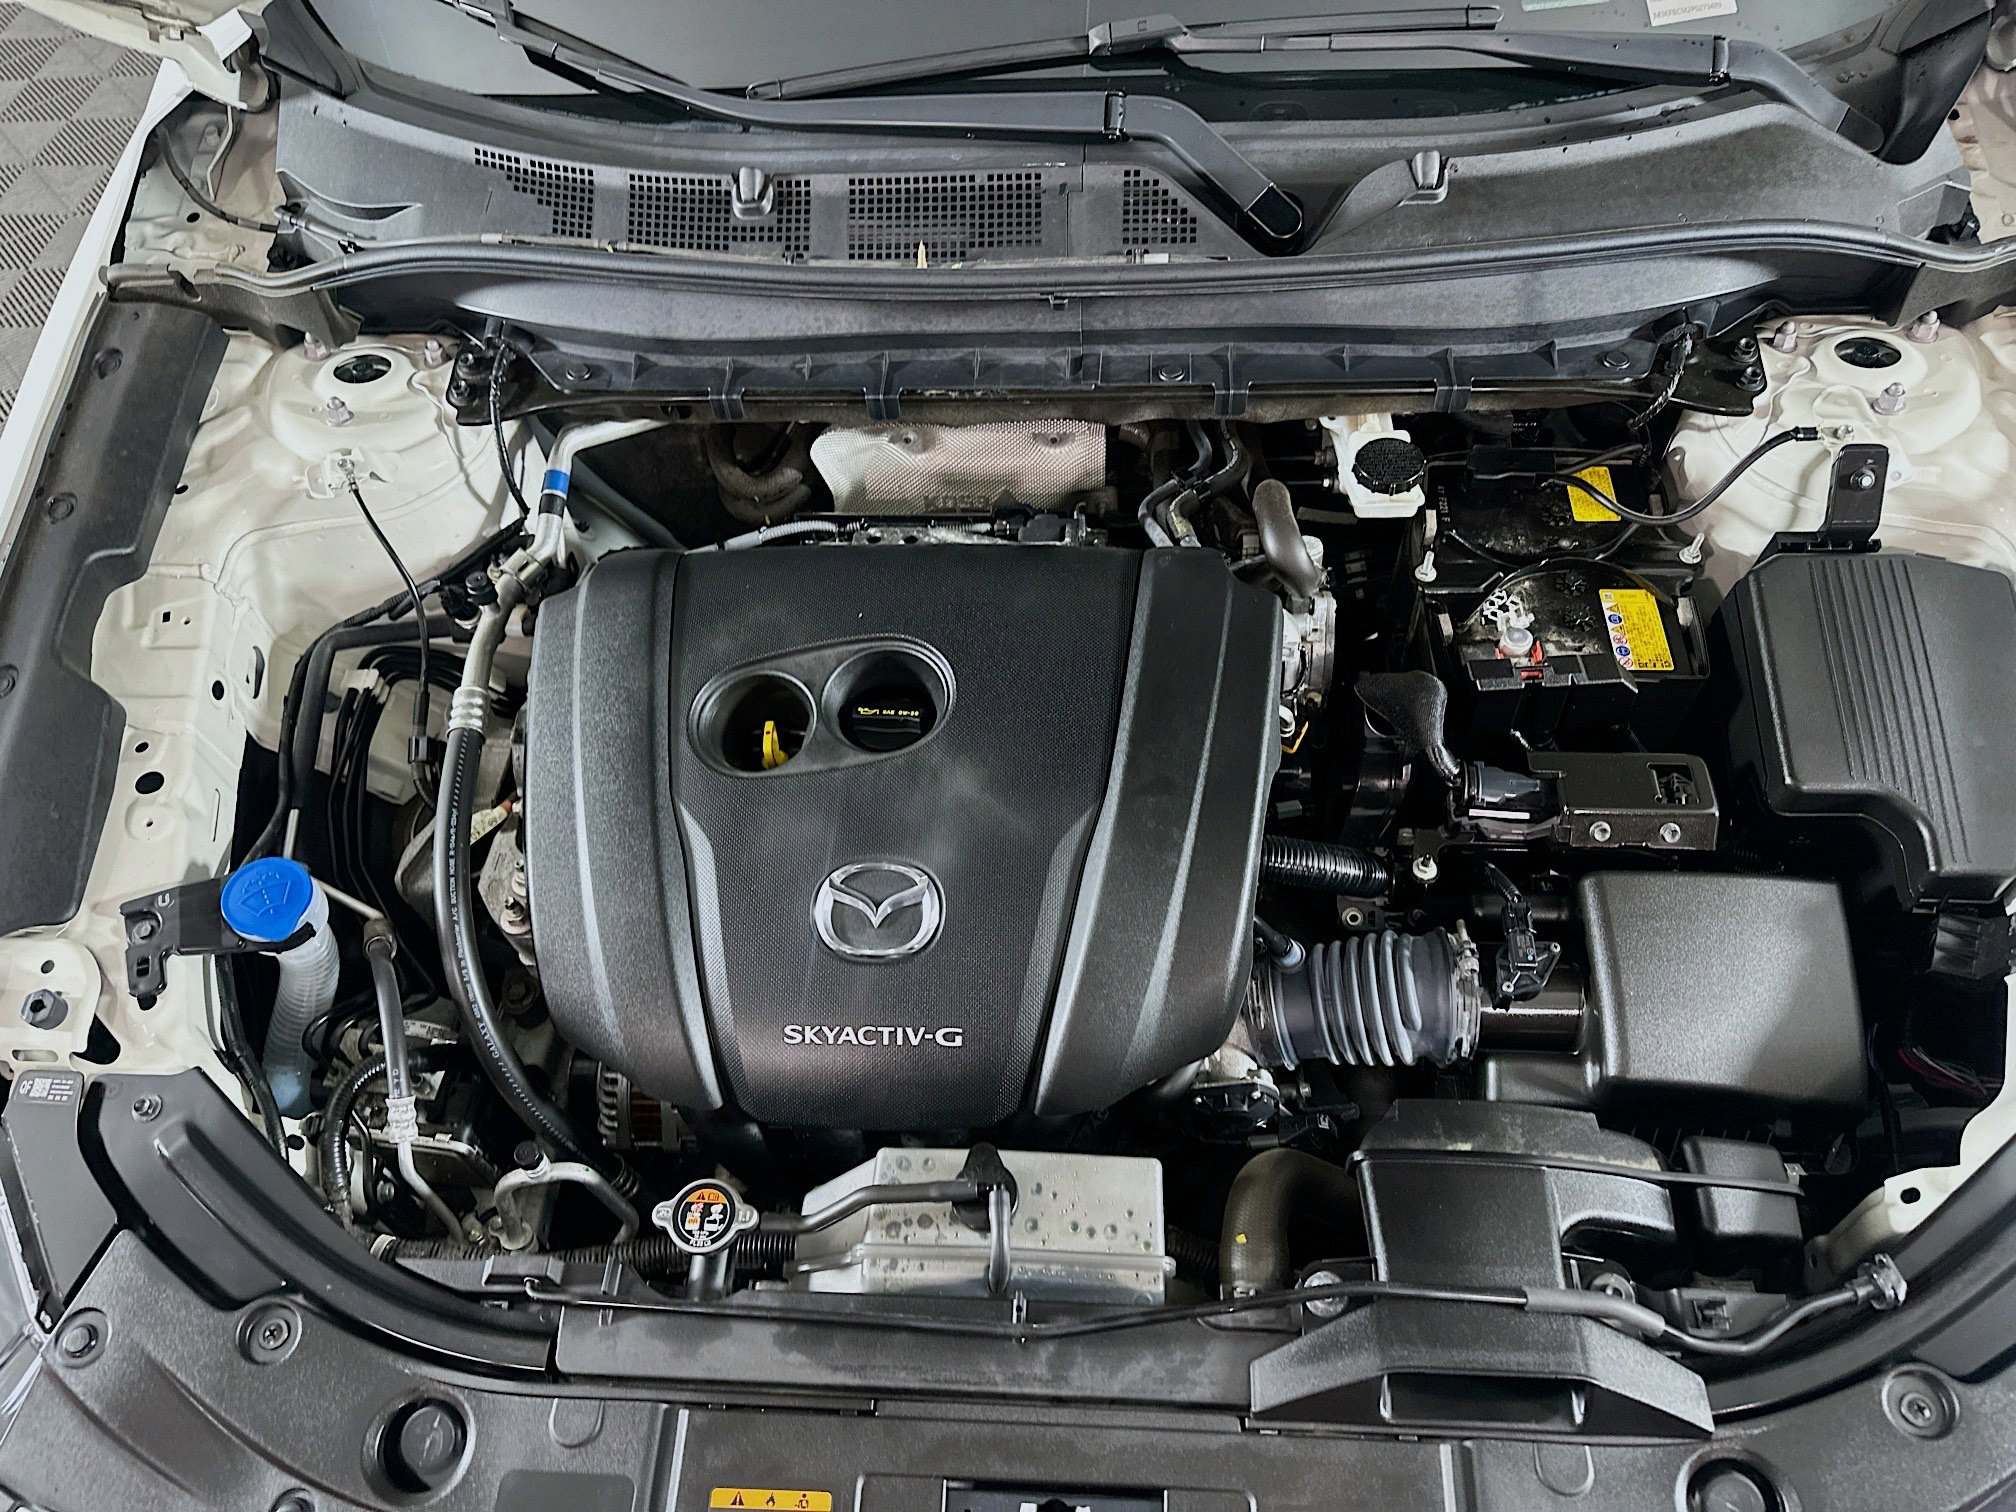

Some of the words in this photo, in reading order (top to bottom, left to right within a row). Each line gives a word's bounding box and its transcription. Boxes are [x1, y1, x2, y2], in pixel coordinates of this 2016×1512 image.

[451, 906, 459, 921] A/C
[477, 1021, 500, 1059] GALAXY
[783, 1024, 963, 1047] SKYACTIV-G
